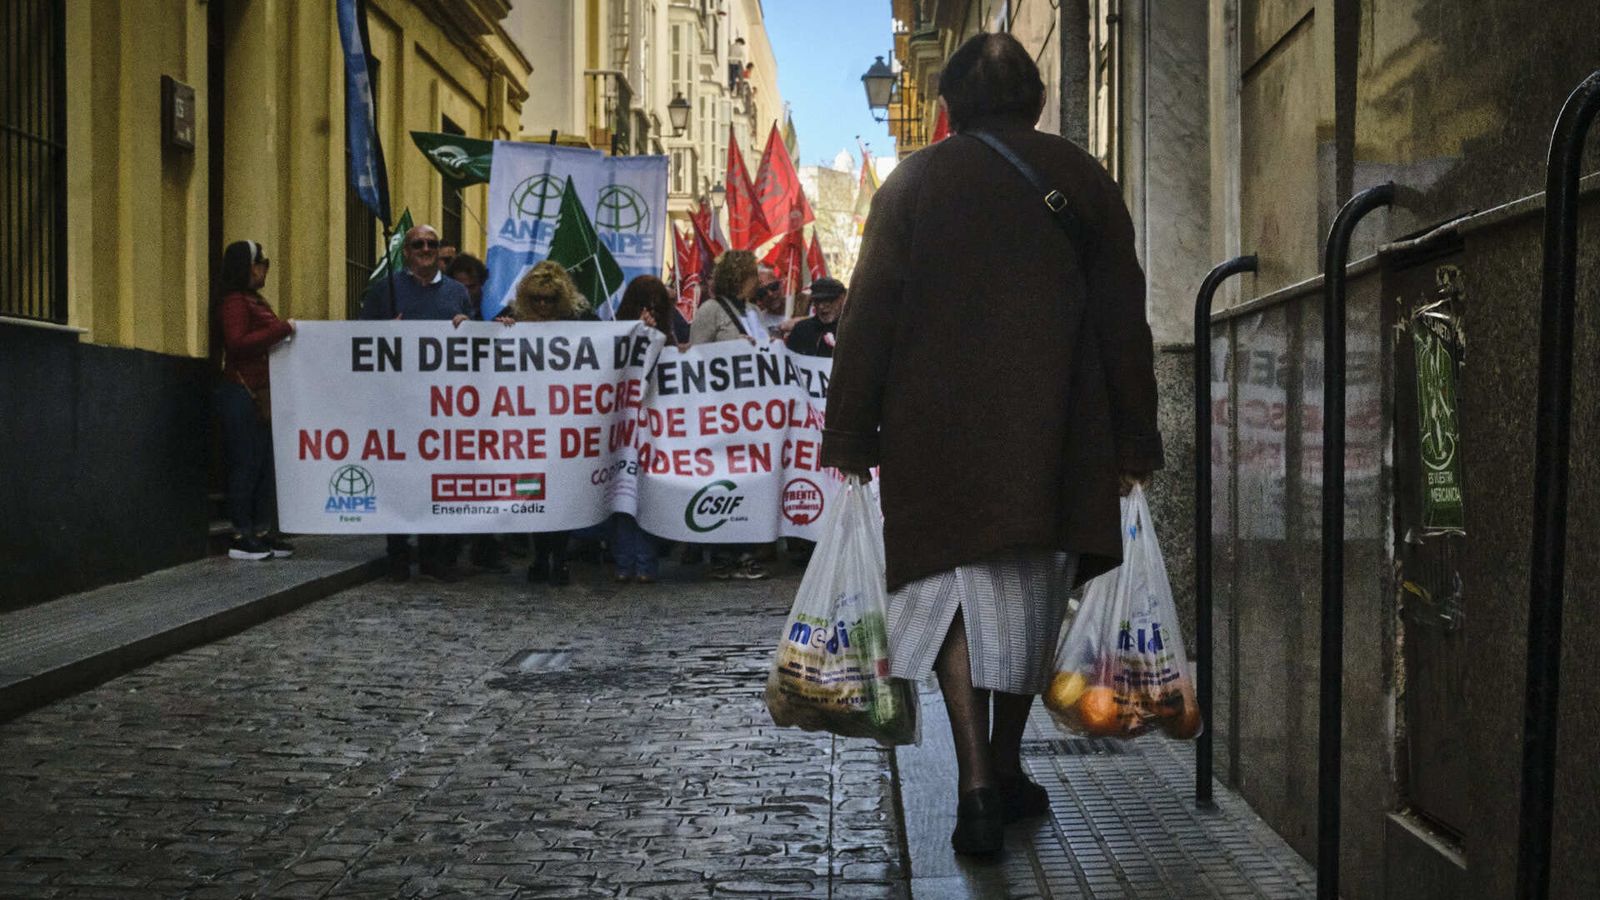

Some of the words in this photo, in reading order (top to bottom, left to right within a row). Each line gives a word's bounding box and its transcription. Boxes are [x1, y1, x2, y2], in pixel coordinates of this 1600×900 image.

[499, 217, 556, 241] ANP
[597, 232, 654, 253] NPE
[351, 336, 402, 372] EN
[418, 336, 599, 372] DEFENSA
[613, 335, 651, 370] DE
[430, 385, 480, 417] NO
[491, 385, 536, 417] AL
[648, 406, 687, 439] DE
[298, 428, 349, 460] NO
[361, 428, 406, 460] AL
[417, 427, 547, 460] CIERRE
[559, 427, 601, 460] DE
[726, 443, 772, 474] EN
[437, 478, 512, 497] CCOO
[325, 496, 377, 510] ANPE
[431, 503, 500, 515] Enseñanza
[511, 503, 545, 515] Cádiz
[696, 495, 744, 515] CSIF
